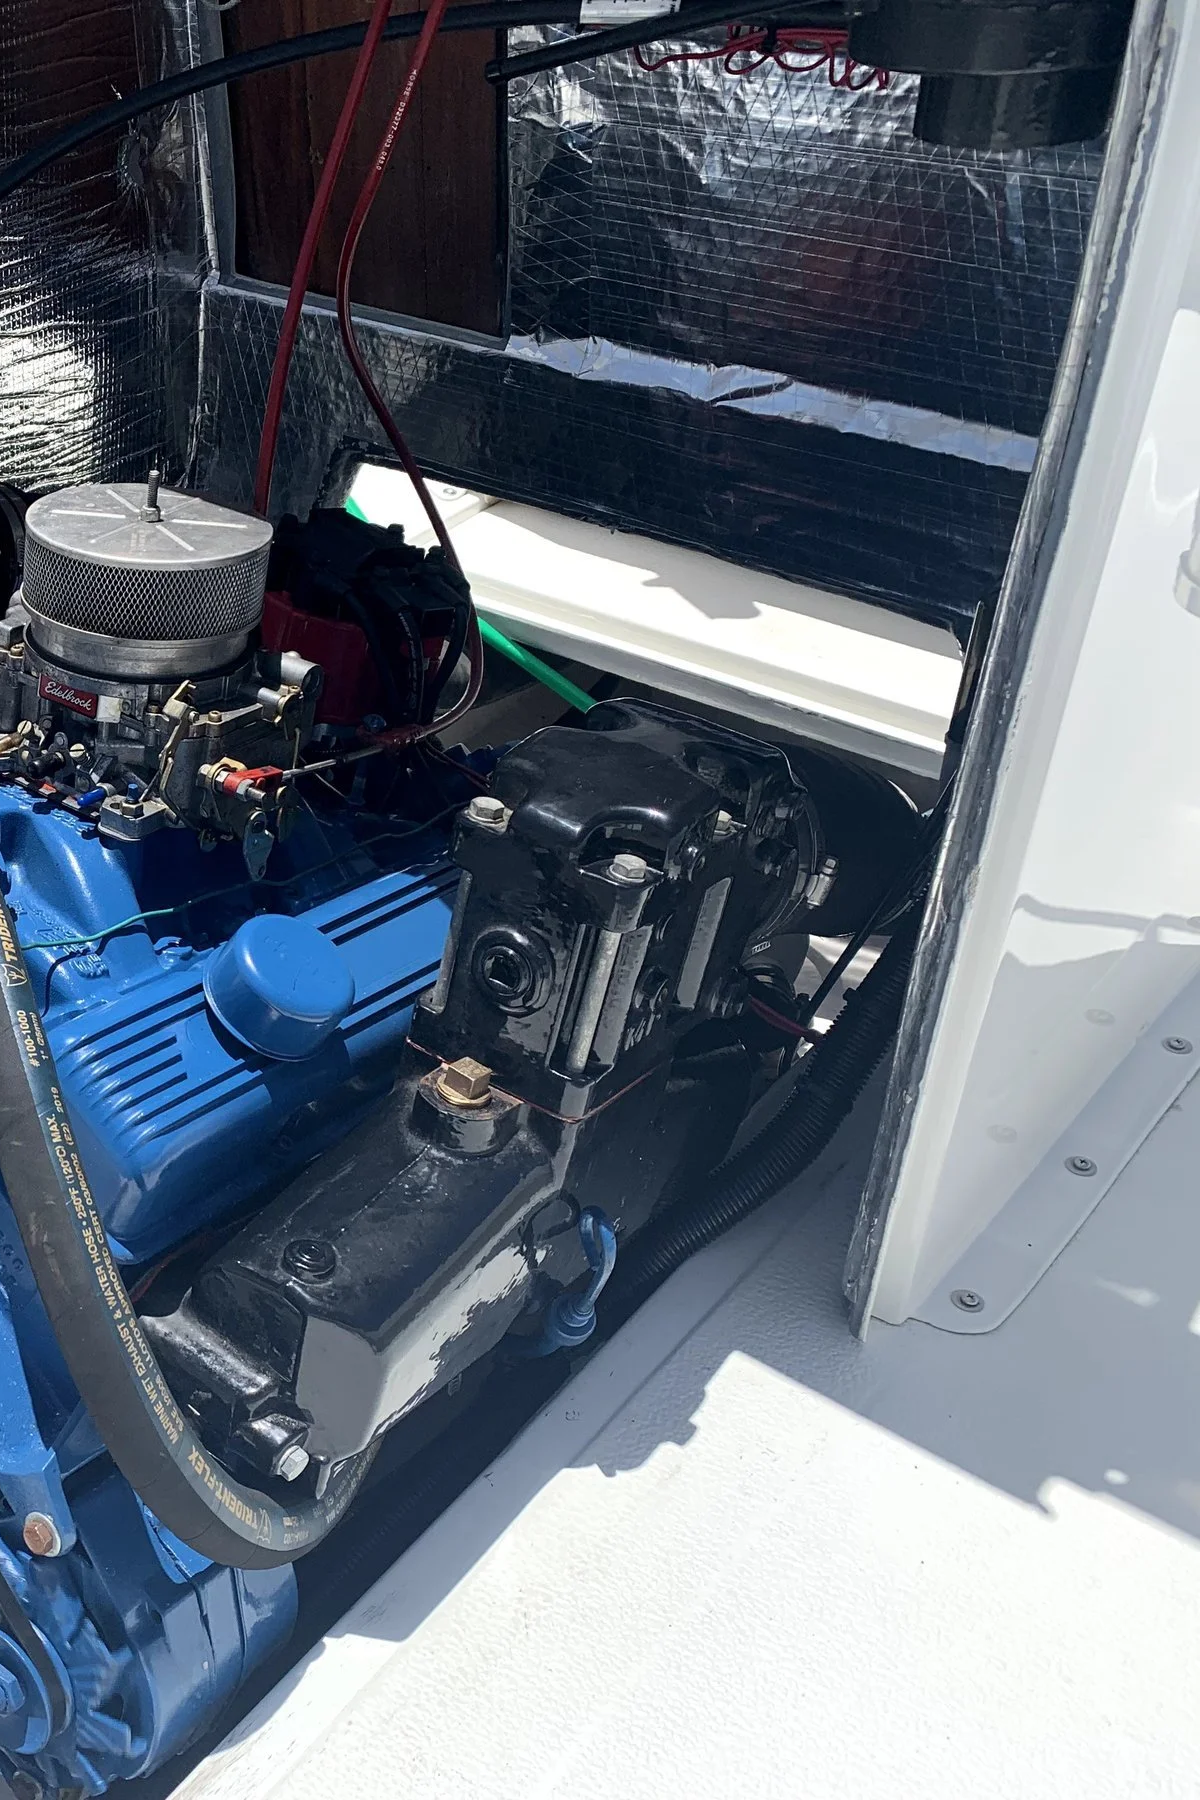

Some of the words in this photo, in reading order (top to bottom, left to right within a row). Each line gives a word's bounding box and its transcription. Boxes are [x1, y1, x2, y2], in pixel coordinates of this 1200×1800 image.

[44, 681, 92, 712] Edelbrock
[15, 1010, 40, 1067] #100-1000
[29, 1011, 45, 1045] (25mm)
[49, 1086, 63, 1112] 2019
[45, 1112, 62, 1142] MAX.
[60, 1122, 74, 1144] (E2)
[88, 1209, 104, 1243] CERT
[81, 1226, 101, 1263] HOSE
[93, 1264, 118, 1309] WATER
[100, 1247, 131, 1313] APPROVED
[111, 1308, 123, 1319] &
[115, 1321, 148, 1375] EXHAUST
[140, 1375, 158, 1403] WET
[153, 1400, 180, 1444] MARINE
[187, 1444, 257, 1530] TRIDENT-FLEX
